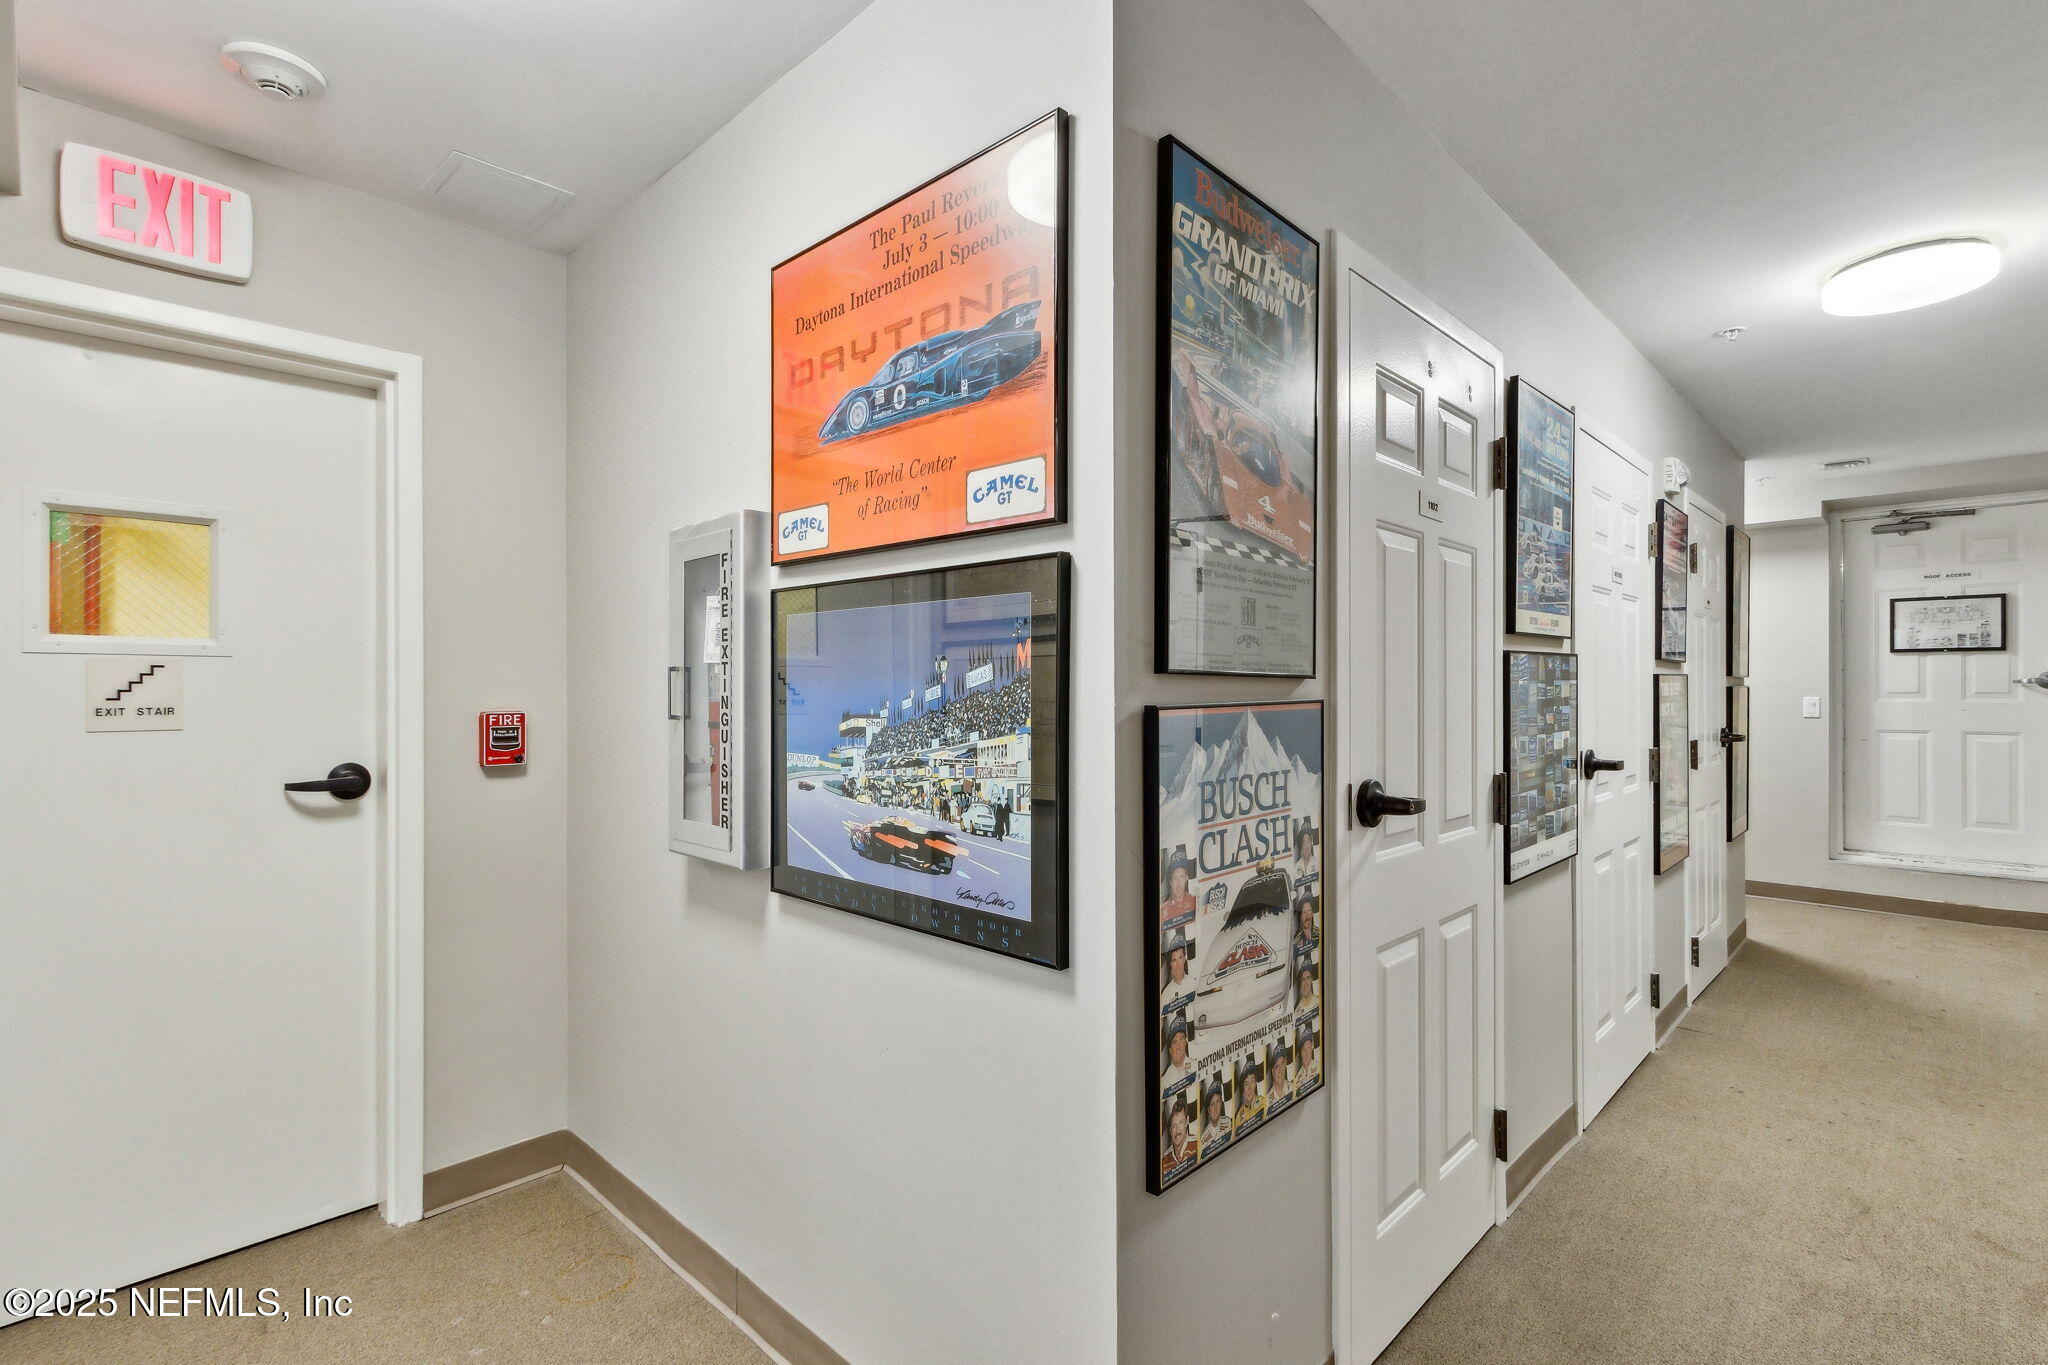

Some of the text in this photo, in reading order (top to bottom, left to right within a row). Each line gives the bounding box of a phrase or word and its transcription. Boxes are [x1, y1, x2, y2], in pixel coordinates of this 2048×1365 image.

[98, 154, 231, 265] EXIT
[869, 226, 896, 251] The
[901, 200, 936, 235] Paul
[1194, 167, 1300, 267] Budweiser
[882, 243, 915, 270] July
[919, 232, 928, 252] 3
[954, 199, 999, 236] 10:00
[1172, 202, 1316, 315] GRAND PRIX
[795, 300, 845, 336] Daytona
[849, 251, 944, 311] International
[1213, 263, 1285, 319] OF MIAMI
[790, 265, 1041, 390] DAYTONA
[893, 383, 907, 410] 0
[864, 462, 904, 488] World
[908, 455, 957, 483] Center
[972, 473, 1039, 504] CAMEL
[857, 498, 870, 521] of
[997, 490, 1013, 506] GT
[1257, 495, 1277, 514] 4
[782, 516, 825, 540] CAMEL
[797, 529, 807, 542] GT
[1246, 512, 1294, 546] Budweiser
[95, 706, 176, 717] EXIT STAIR
[721, 552, 729, 830] FIRE EXTINGUISHER
[489, 714, 522, 726] FIRE
[787, 753, 818, 764] DUNLOP
[1198, 768, 1292, 825] BUSCH
[1198, 814, 1292, 875] CLASH
[801, 885, 1009, 948] RANDY OWENS
[977, 919, 1023, 937] HOUR
[1197, 1047, 1226, 1072] DAYTONA
[1225, 1026, 1268, 1056] INTERNATIONAL
[1267, 1013, 1294, 1034] SPEEDWAY
